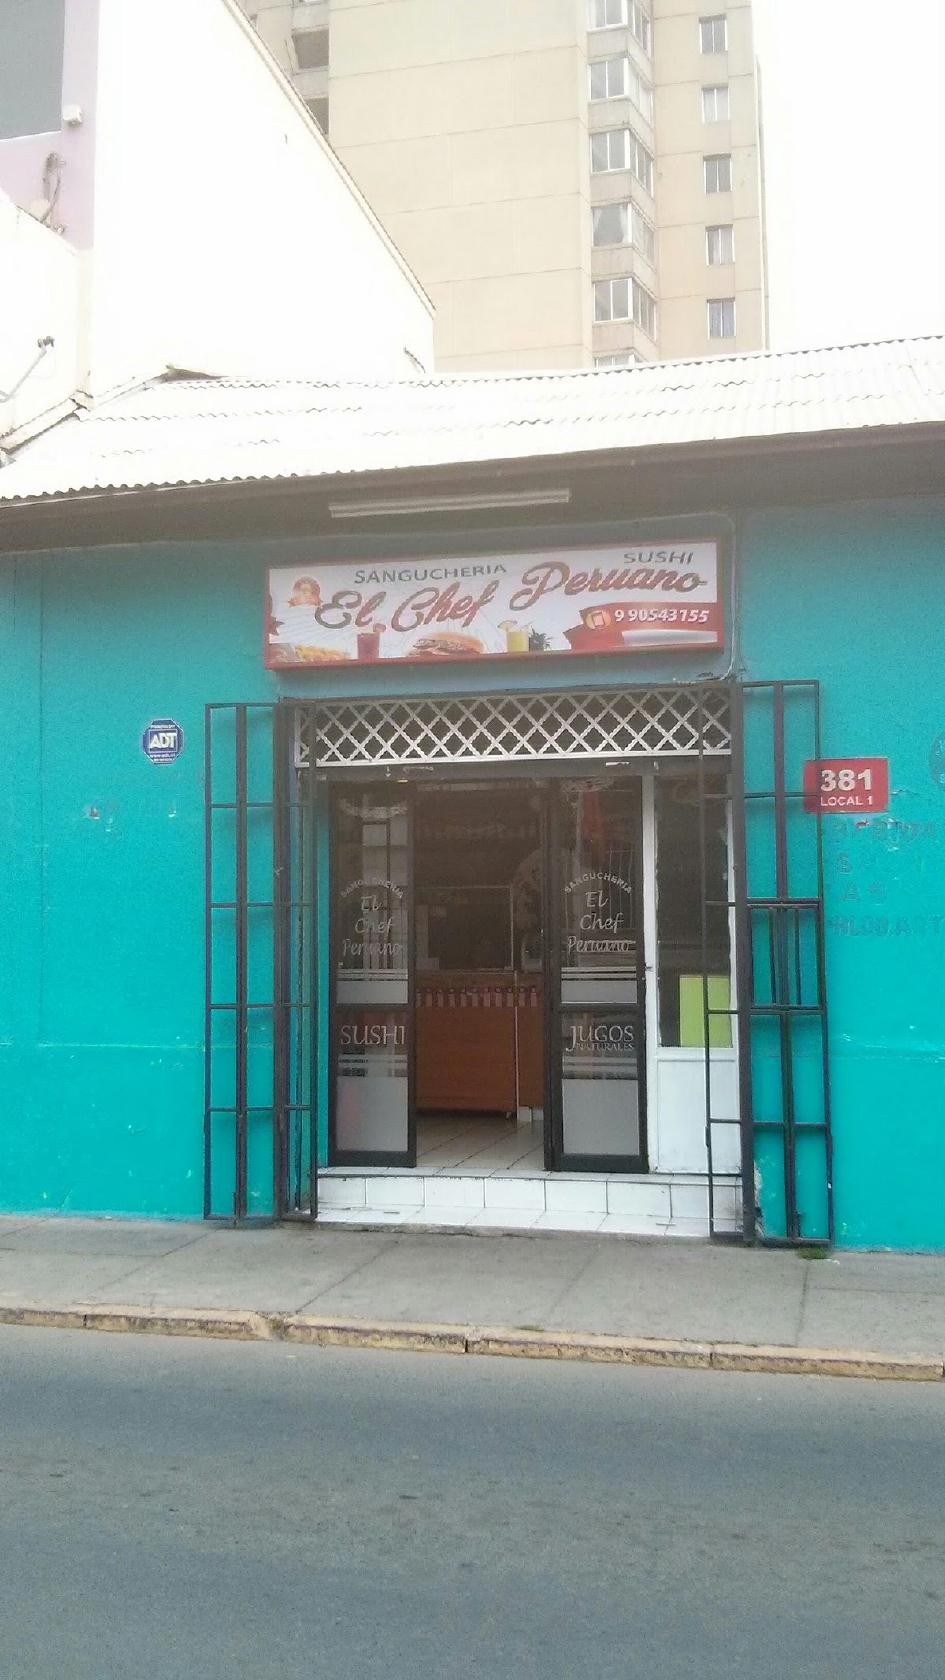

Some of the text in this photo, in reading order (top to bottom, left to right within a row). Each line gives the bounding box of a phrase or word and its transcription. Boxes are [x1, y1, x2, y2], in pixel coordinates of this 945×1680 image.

[624, 551, 694, 565] SUSHI
[354, 564, 507, 584] SANGUCHERIA
[314, 561, 708, 632] El Chef Peruano
[614, 609, 625, 622] 9
[149, 732, 177, 749] ADT
[820, 769, 872, 791] 381
[820, 795, 873, 807] LOCAL 1
[565, 872, 632, 894] SANGUCHERIA
[360, 894, 382, 911] El
[585, 890, 609, 908] El
[355, 916, 396, 940] Chef
[580, 912, 624, 934] Chef
[568, 936, 636, 956] Peruano
[340, 1025, 406, 1045] SUSHI
[565, 1025, 634, 1052] JUGOS
[576, 1042, 635, 1052] NATURALES
